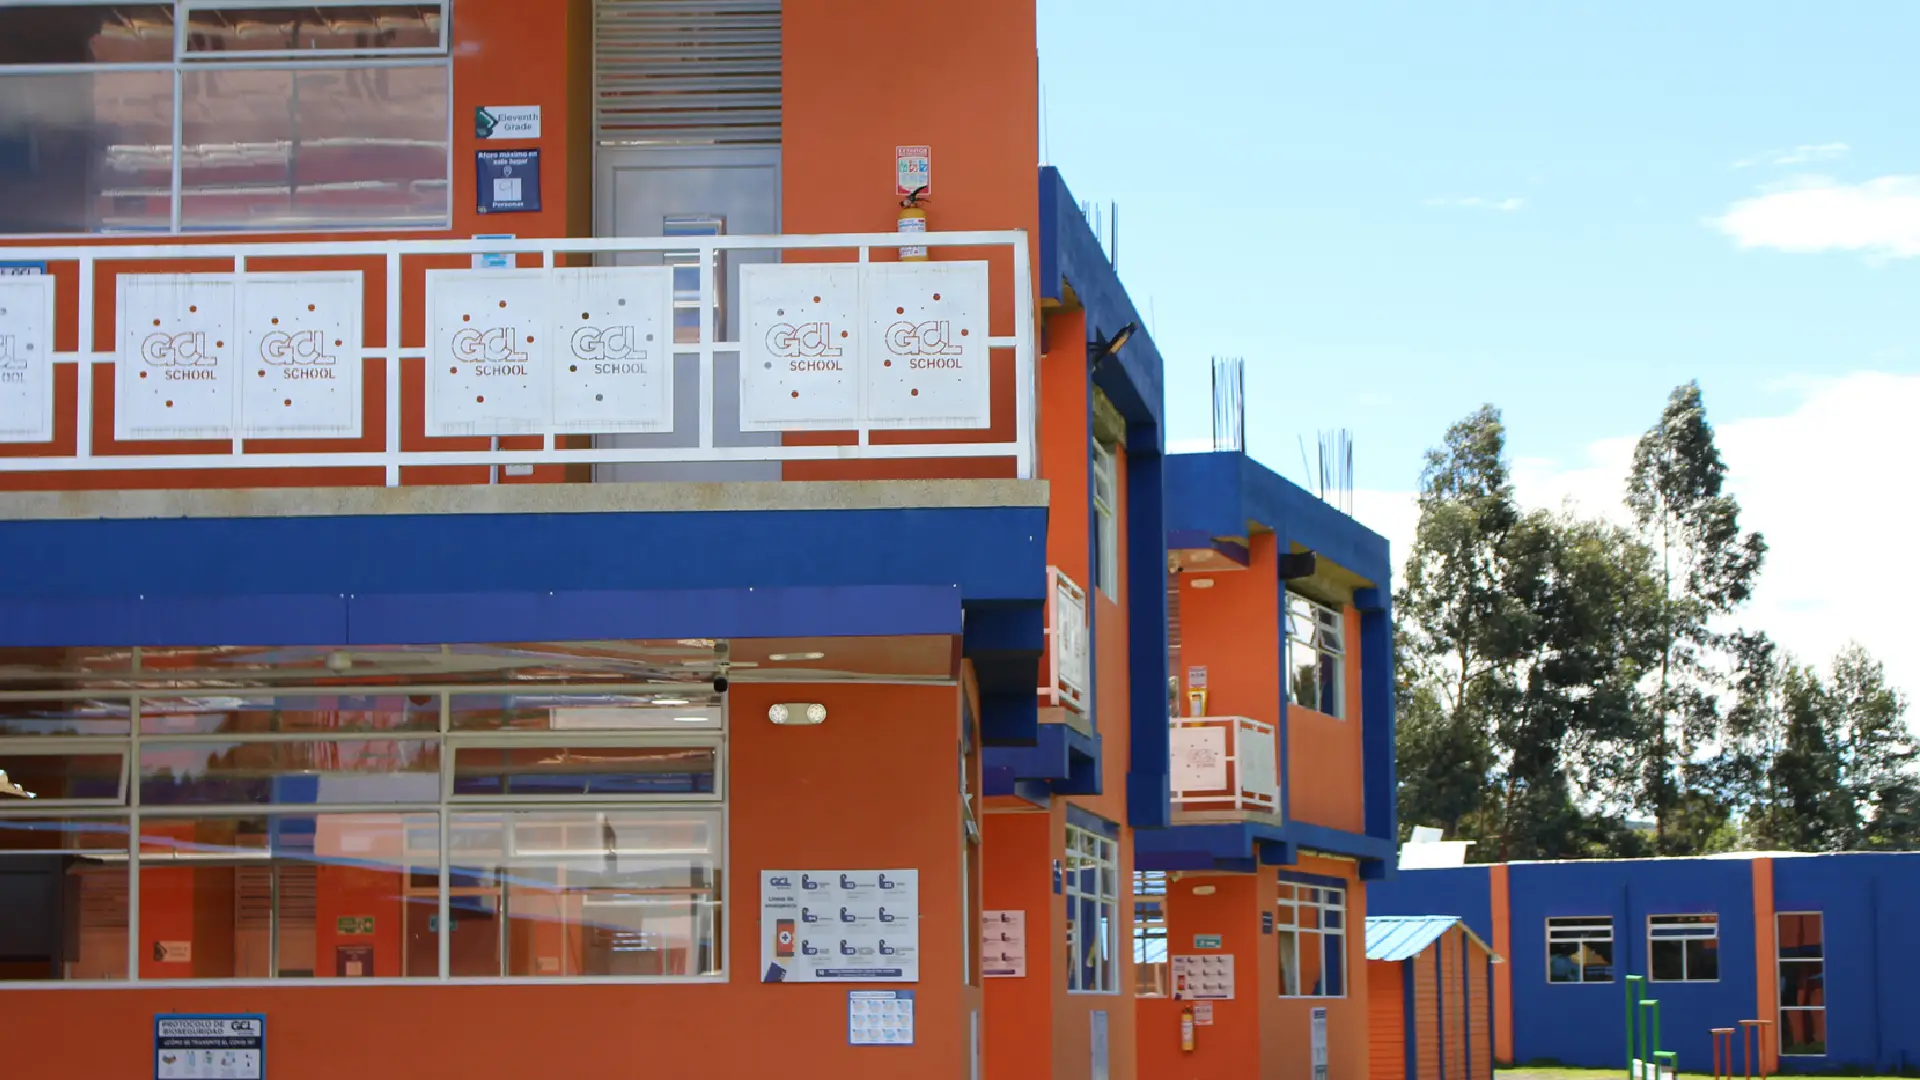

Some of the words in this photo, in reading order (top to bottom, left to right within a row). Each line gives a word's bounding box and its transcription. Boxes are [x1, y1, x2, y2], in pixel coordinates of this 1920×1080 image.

[498, 113, 539, 121] Eleventh
[504, 123, 532, 131] Grade
[570, 326, 647, 360] GCL
[765, 322, 843, 358] GCL
[885, 320, 963, 355] GCL
[141, 331, 217, 366] GCL
[260, 330, 336, 365] GCL
[451, 327, 528, 363] GCL
[594, 363, 647, 374] SCHOOL
[790, 360, 843, 371] SCHOOL
[909, 358, 963, 369] SCHOOL
[165, 370, 217, 380] SCHOOL
[283, 368, 336, 379] SCHOOL
[475, 365, 528, 376] SCHOOL
[231, 1020, 254, 1031] GCL
